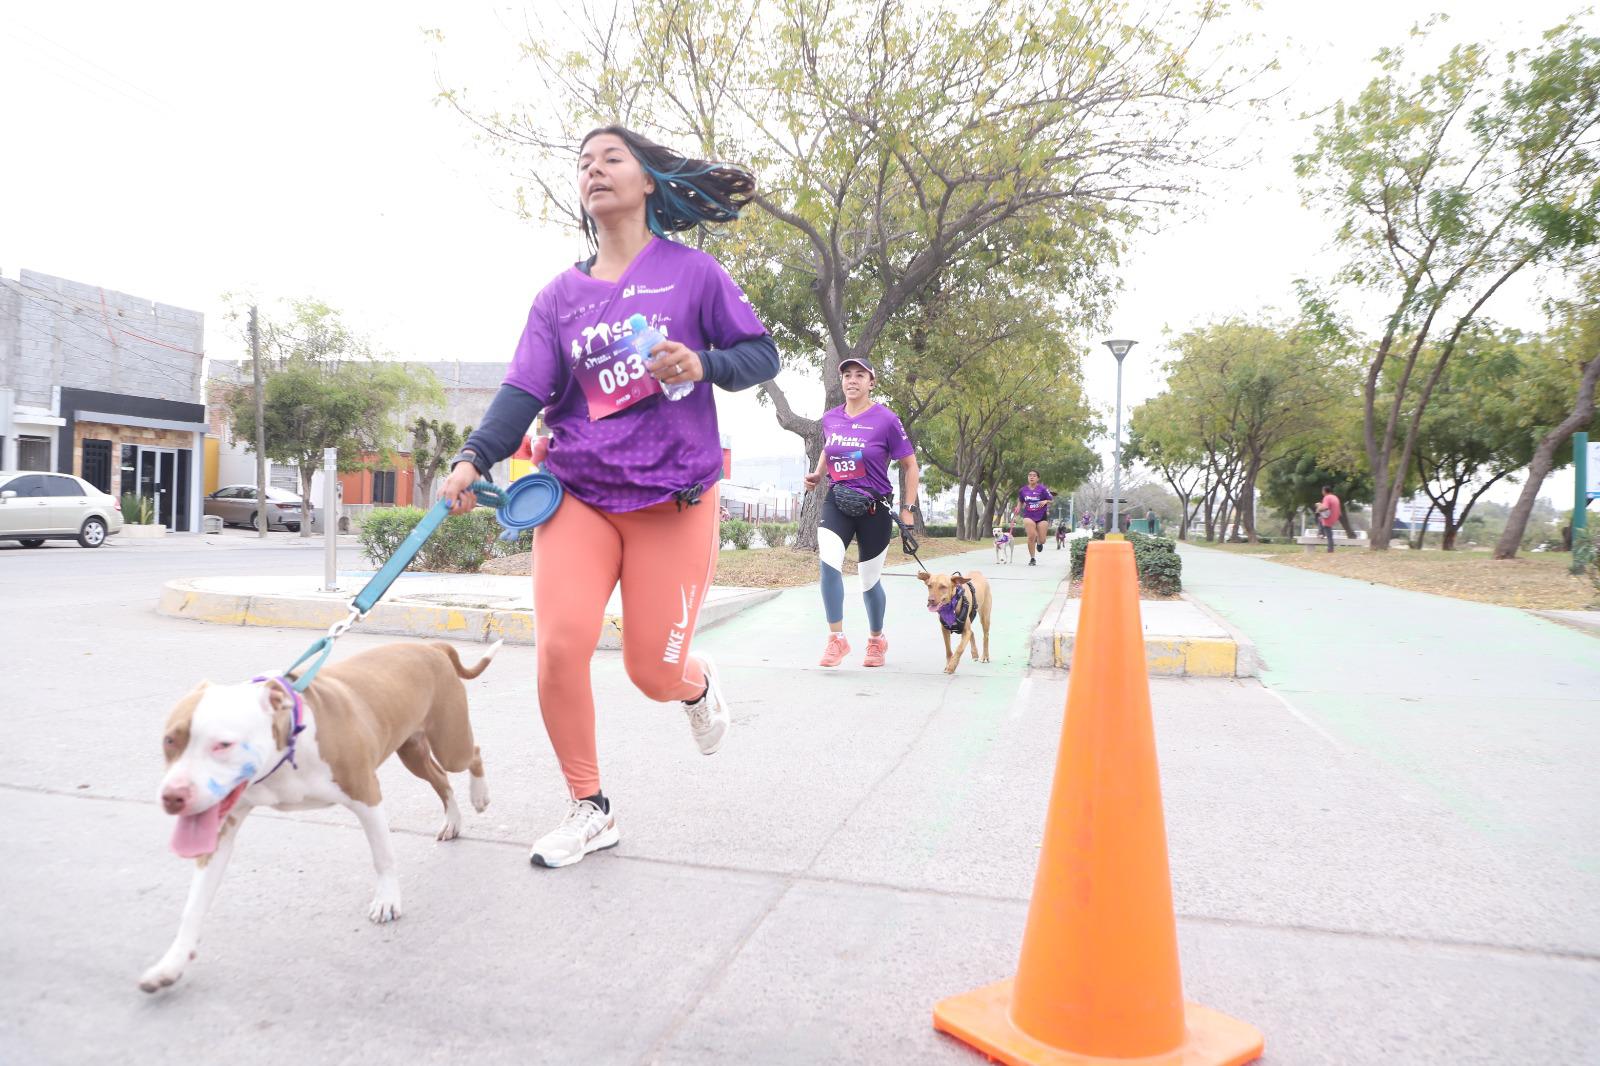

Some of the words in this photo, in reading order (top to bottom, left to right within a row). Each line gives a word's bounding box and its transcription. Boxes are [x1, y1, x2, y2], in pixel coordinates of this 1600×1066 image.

[598, 353, 645, 395] 083
[834, 460, 856, 473] 033
[663, 629, 686, 664] NIKE
